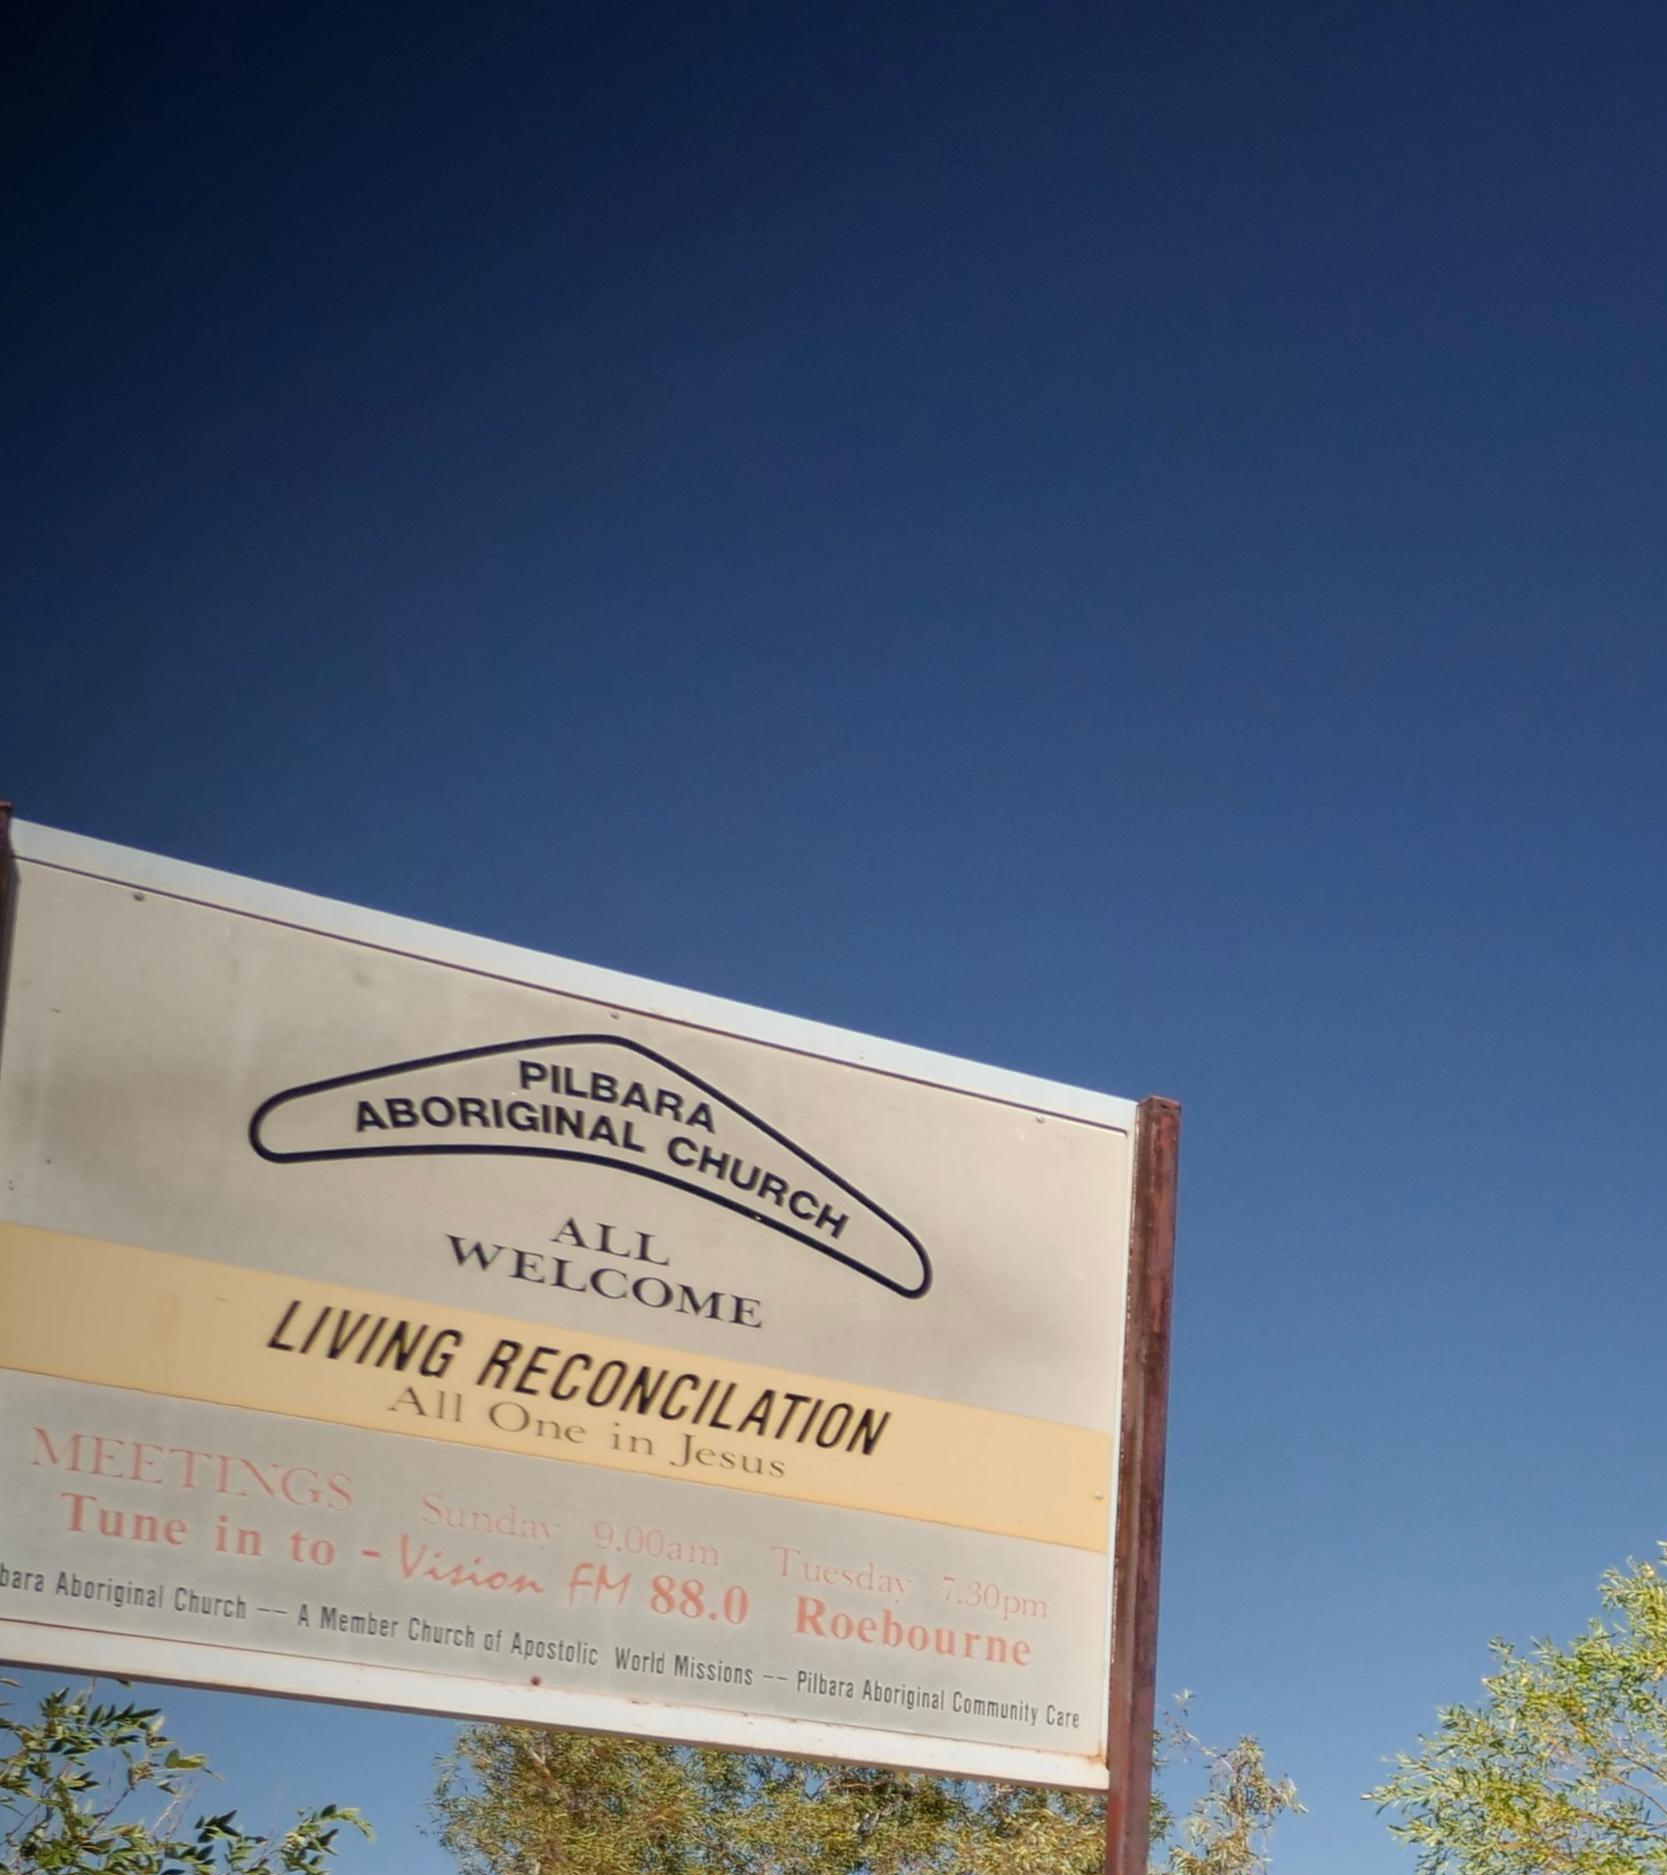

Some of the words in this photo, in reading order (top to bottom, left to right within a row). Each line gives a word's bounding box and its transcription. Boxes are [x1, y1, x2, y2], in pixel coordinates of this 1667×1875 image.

[355, 1096, 647, 1154] ABORIGINAL
[667, 1135, 849, 1238] CHURCH
[518, 1060, 716, 1134] PILBARA
[445, 1234, 763, 1329] WELCOME
[549, 1216, 671, 1266] ALL
[266, 1300, 463, 1379] LIVING
[476, 1338, 892, 1456] RECONCILATION
[387, 1386, 463, 1423] All
[488, 1401, 586, 1445] One
[612, 1423, 653, 1456] in
[670, 1432, 785, 1479] Jesus
[30, 1427, 353, 1511] MEETINGS
[421, 1492, 560, 1550] Sunday
[593, 1520, 720, 1568] 9.00am
[769, 1546, 912, 1603] Tuesday
[943, 1575, 1049, 1621] 7.30pm
[61, 1492, 189, 1546] Tune
[214, 1515, 262, 1557] in
[290, 1529, 336, 1567] to
[399, 1533, 544, 1595] Vision
[568, 1562, 632, 1606] FM
[649, 1574, 750, 1625] 88.0
[793, 1595, 1032, 1667] Roebourne
[56, 1571, 164, 1608] Aboriginal
[174, 1587, 246, 1620] Church
[298, 1603, 310, 1628] A
[320, 1605, 398, 1639] Member
[408, 1616, 476, 1644] Church
[484, 1628, 503, 1653] of
[511, 1631, 598, 1667] Apostolic
[615, 1646, 665, 1675] World
[674, 1654, 753, 1686] Missions
[797, 1669, 854, 1699] Pilbara
[862, 1679, 944, 1710] Aboriginal
[952, 1691, 1038, 1727] Community
[1046, 1704, 1080, 1729] Care
